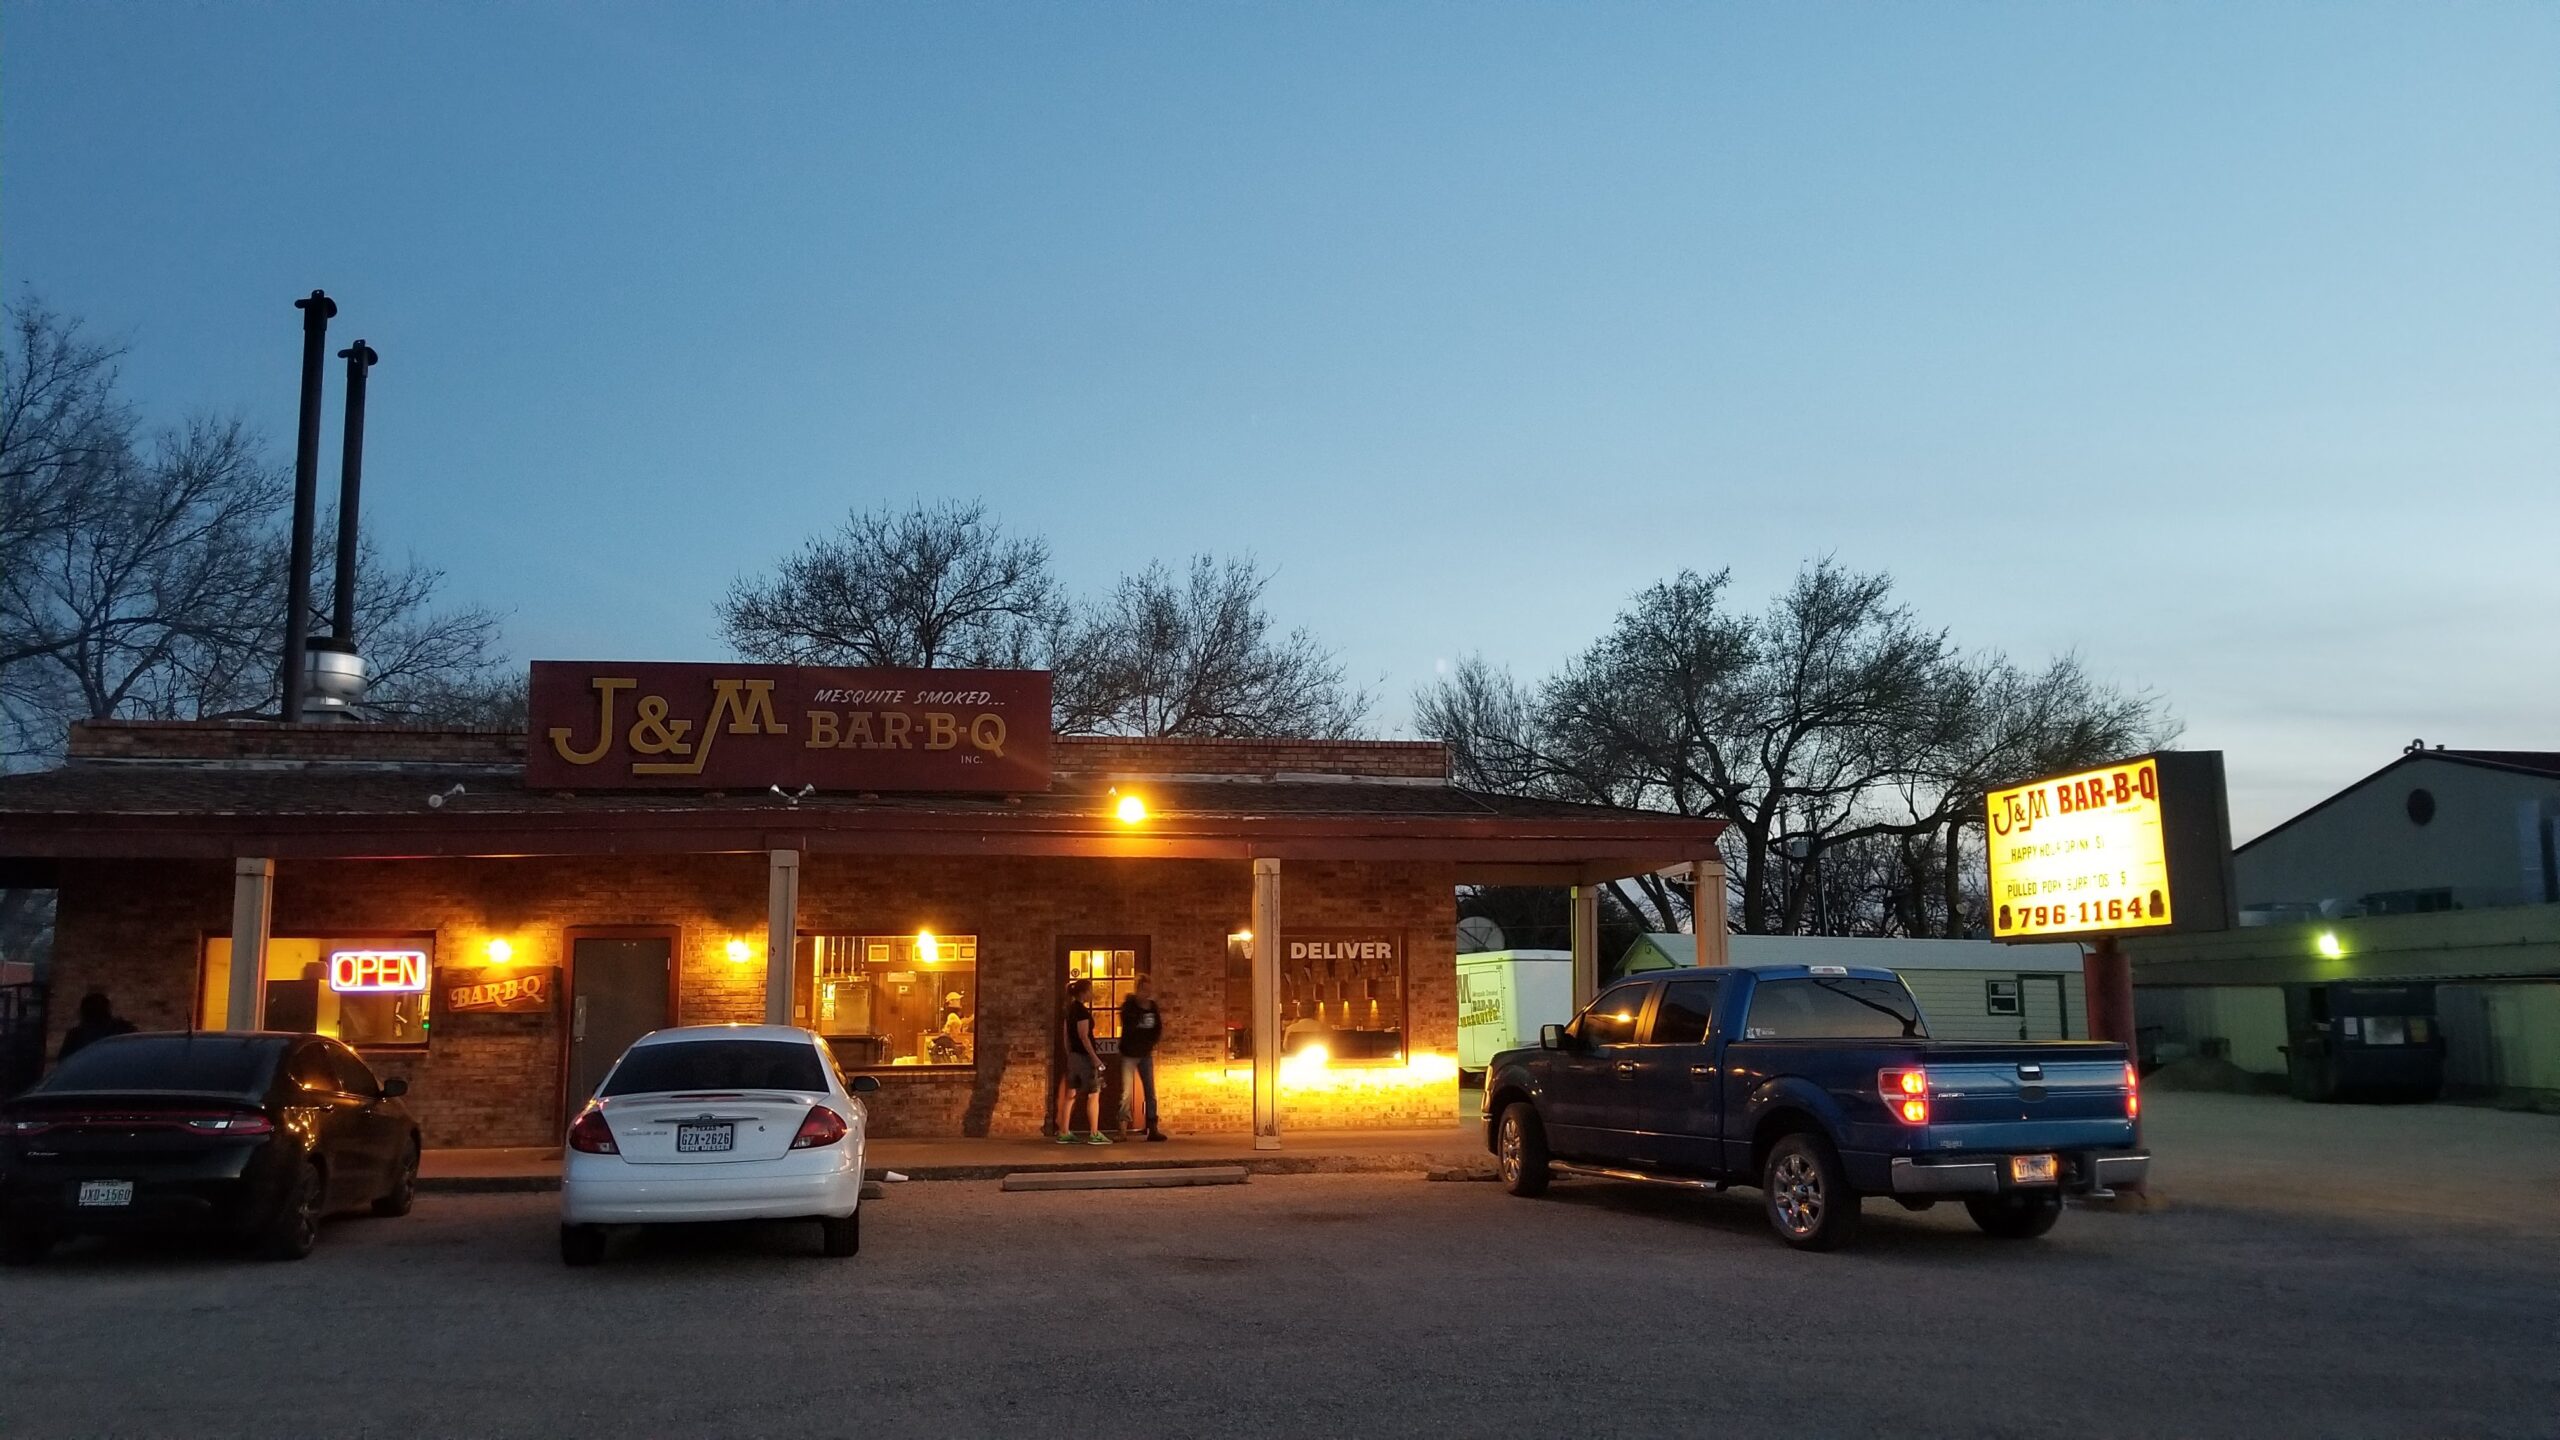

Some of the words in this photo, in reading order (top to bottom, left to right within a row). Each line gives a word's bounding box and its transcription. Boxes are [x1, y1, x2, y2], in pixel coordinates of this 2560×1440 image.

[814, 689, 906, 707] MESQUITE
[549, 677, 788, 775] J&M
[960, 755, 983, 764] INC.
[1993, 789, 2050, 836] J&M
[2057, 766, 2156, 815] BAR-B-Q
[2011, 845, 2037, 863] HAPPY
[2040, 841, 2061, 857] HOR
[2008, 882, 2037, 898] PULLED
[2067, 873, 2110, 891] BURRTOS
[2018, 897, 2143, 928] 796-1164
[1290, 942, 1392, 959] DELIVER
[336, 955, 420, 986] OPEN
[451, 975, 545, 1008] BAR-B-Q
[1095, 1041, 1117, 1052] XIT
